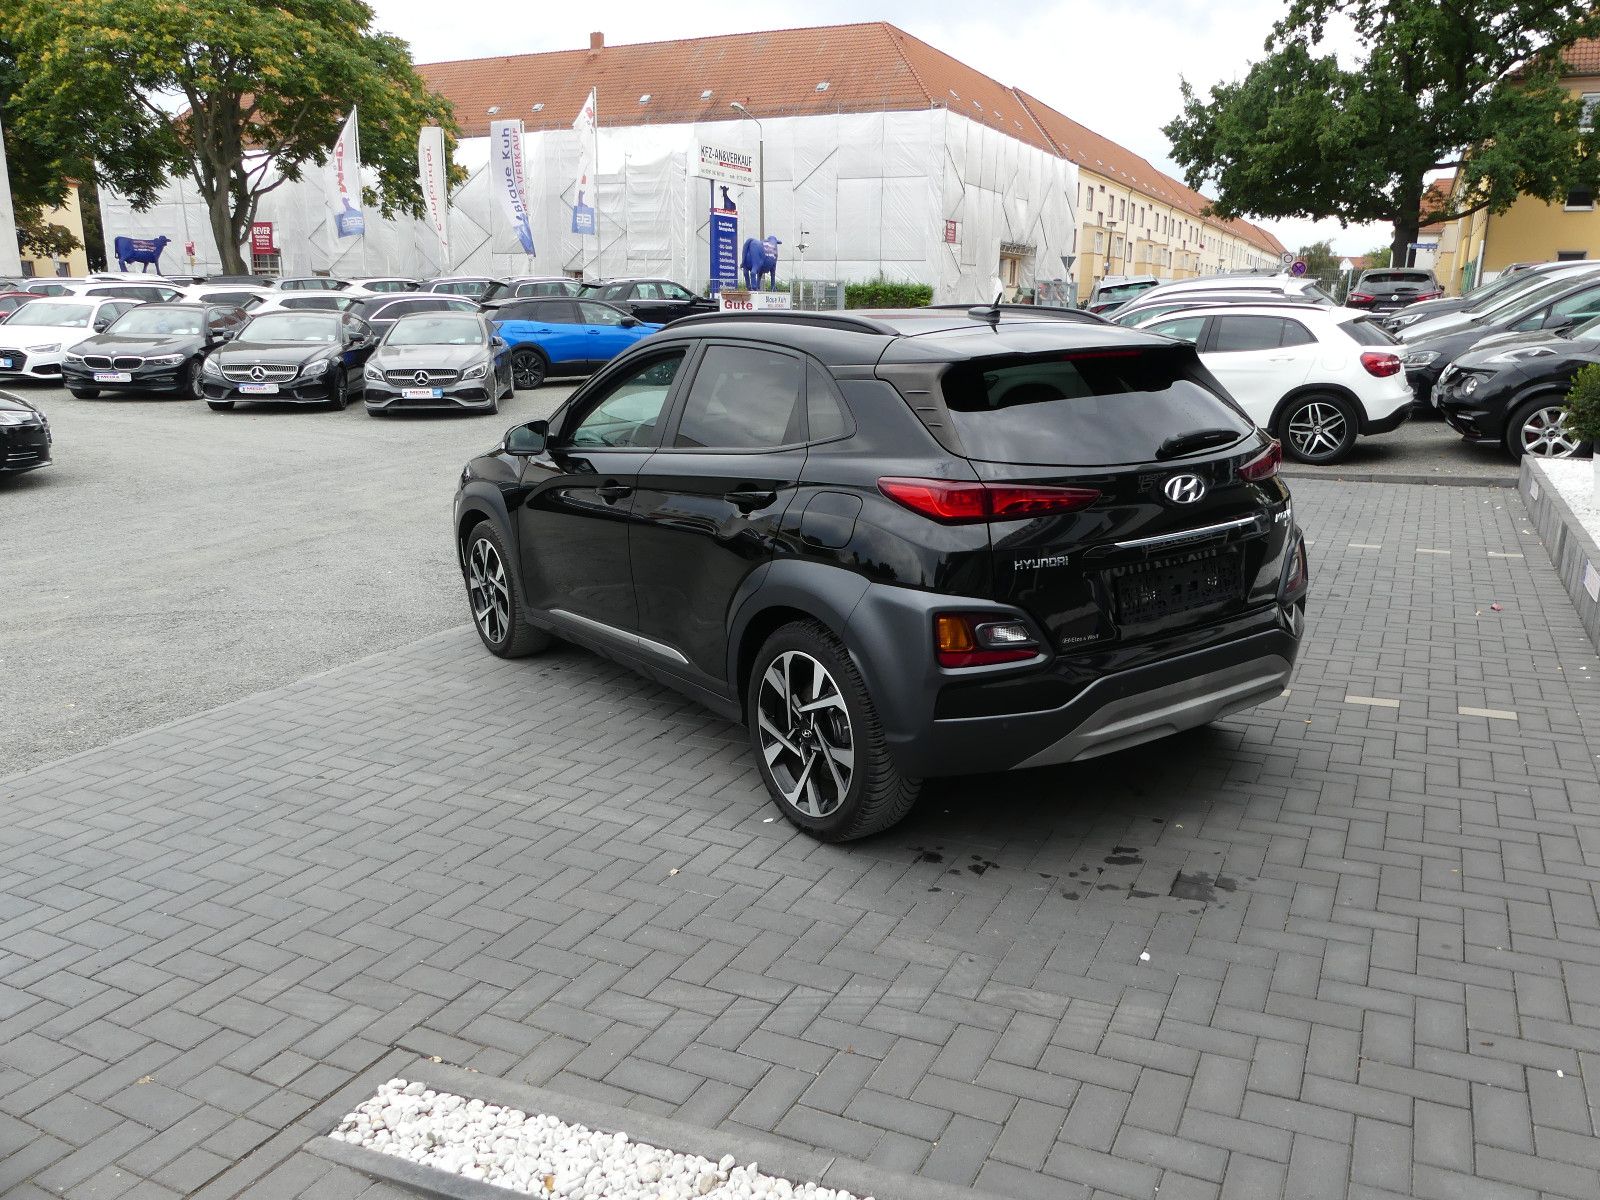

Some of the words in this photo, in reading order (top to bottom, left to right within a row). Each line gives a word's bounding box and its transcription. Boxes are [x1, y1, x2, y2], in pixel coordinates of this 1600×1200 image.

[502, 127, 511, 160] Kuh
[504, 166, 523, 213] Blaue
[724, 300, 753, 310] Gute
[1014, 555, 1069, 571] HYUNDAI
